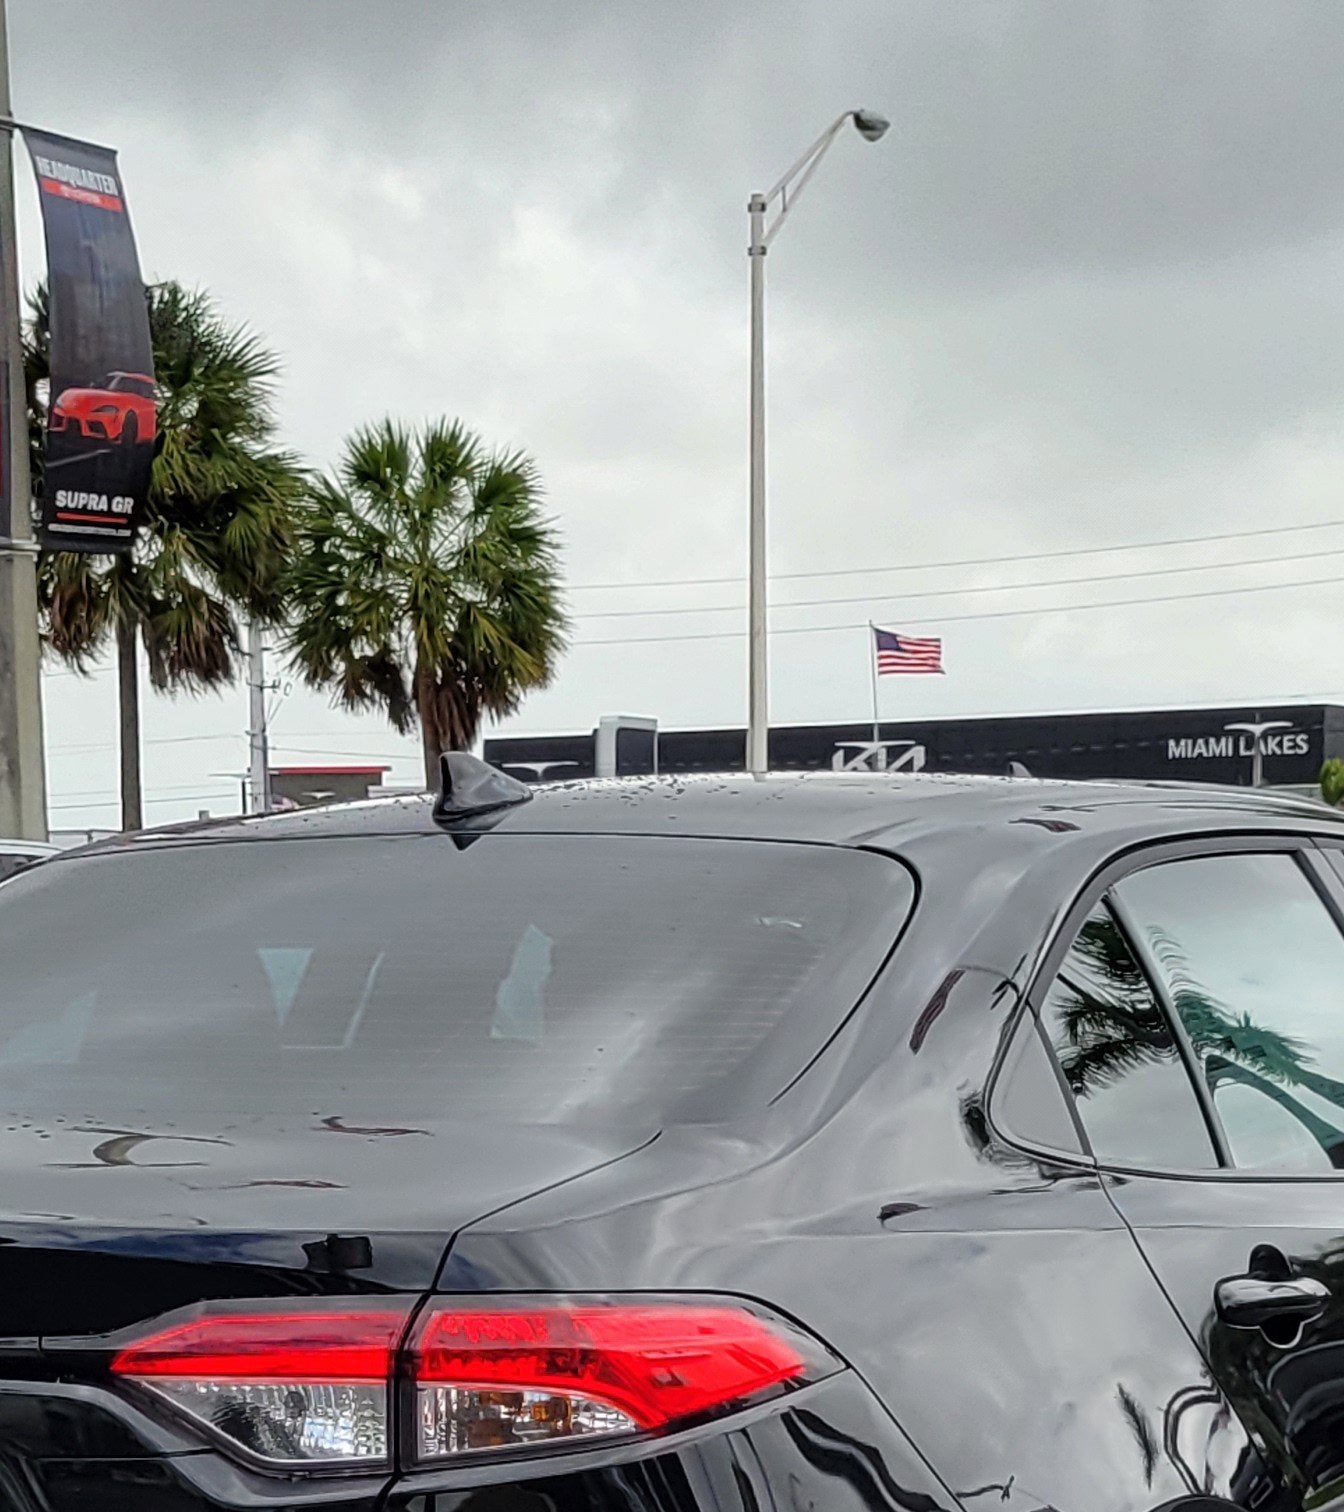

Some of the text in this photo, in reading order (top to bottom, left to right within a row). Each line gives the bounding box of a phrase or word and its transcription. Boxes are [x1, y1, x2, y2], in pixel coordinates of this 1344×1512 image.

[56, 489, 134, 514] SUPRA GR
[832, 744, 926, 772] KIA
[1168, 733, 1310, 760] MIAMI LAKES
